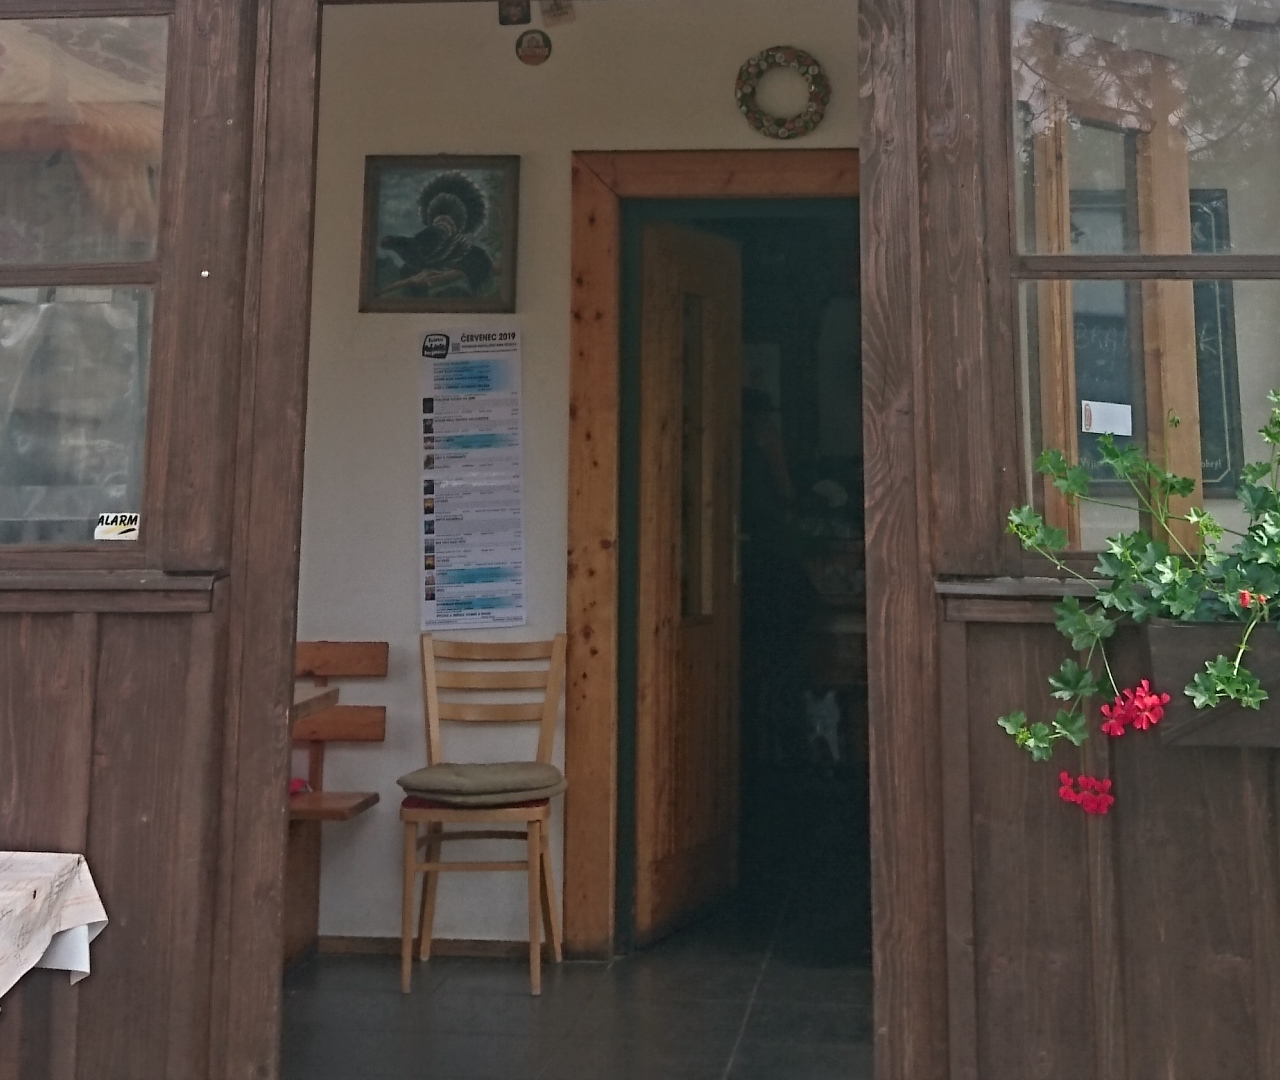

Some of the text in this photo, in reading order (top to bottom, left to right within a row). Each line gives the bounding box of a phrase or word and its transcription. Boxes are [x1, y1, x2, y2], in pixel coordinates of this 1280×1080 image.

[460, 332, 516, 343] ČERVENEC 2019
[97, 514, 138, 526] ALARM
